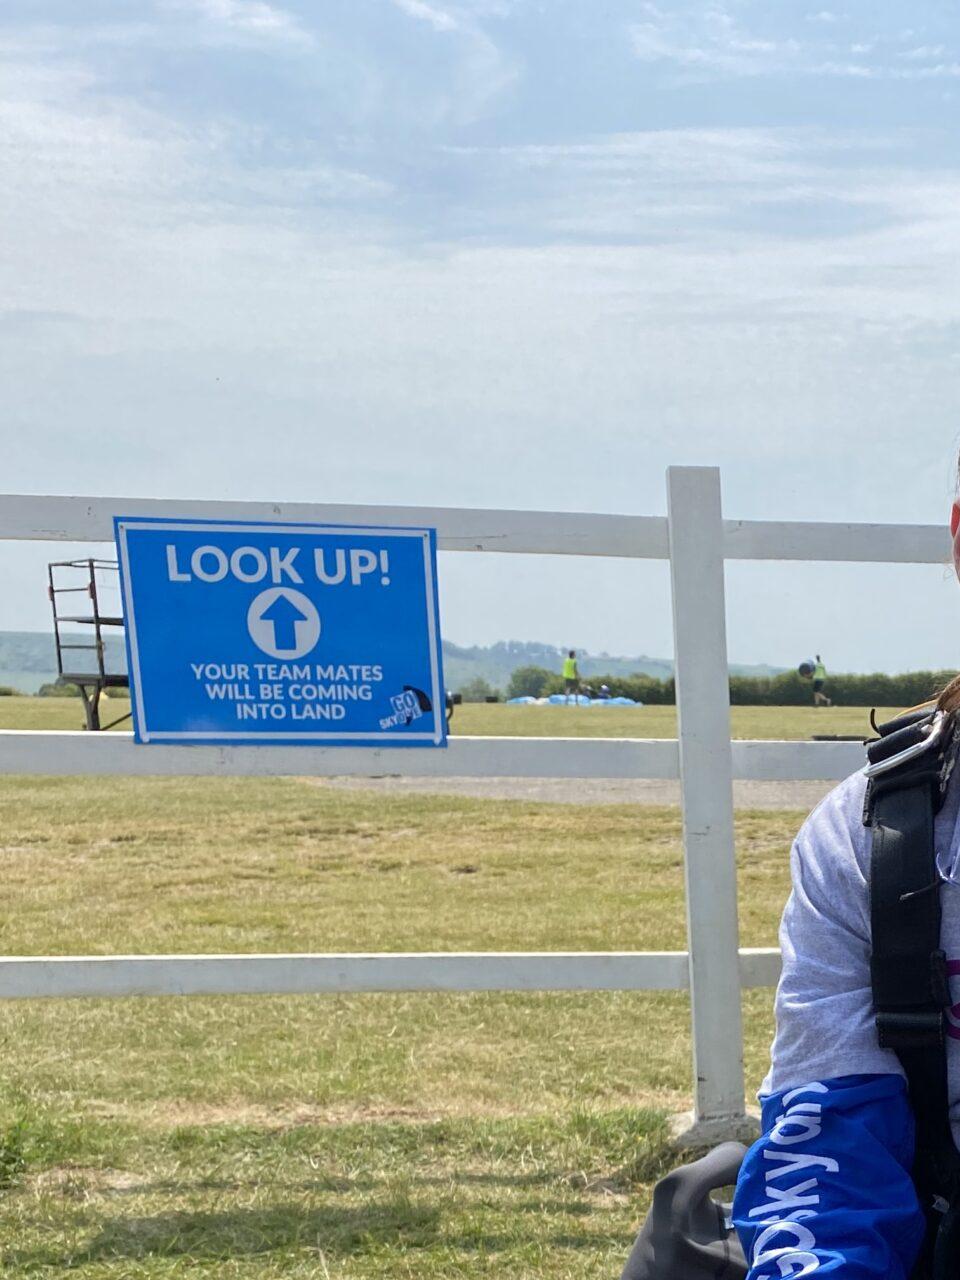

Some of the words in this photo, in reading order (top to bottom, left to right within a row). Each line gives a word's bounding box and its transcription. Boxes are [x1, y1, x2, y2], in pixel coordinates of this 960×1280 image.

[165, 544, 304, 584] LOOK
[314, 548, 391, 586] UP!
[190, 663, 250, 681] YOUR
[254, 664, 311, 681] TEAM
[316, 664, 383, 682] MATES
[205, 683, 255, 701] WILL
[259, 684, 283, 701] BE
[288, 684, 373, 702] COMING
[236, 703, 287, 720] INTO
[291, 703, 346, 721] LAND
[392, 693, 416, 713] GO
